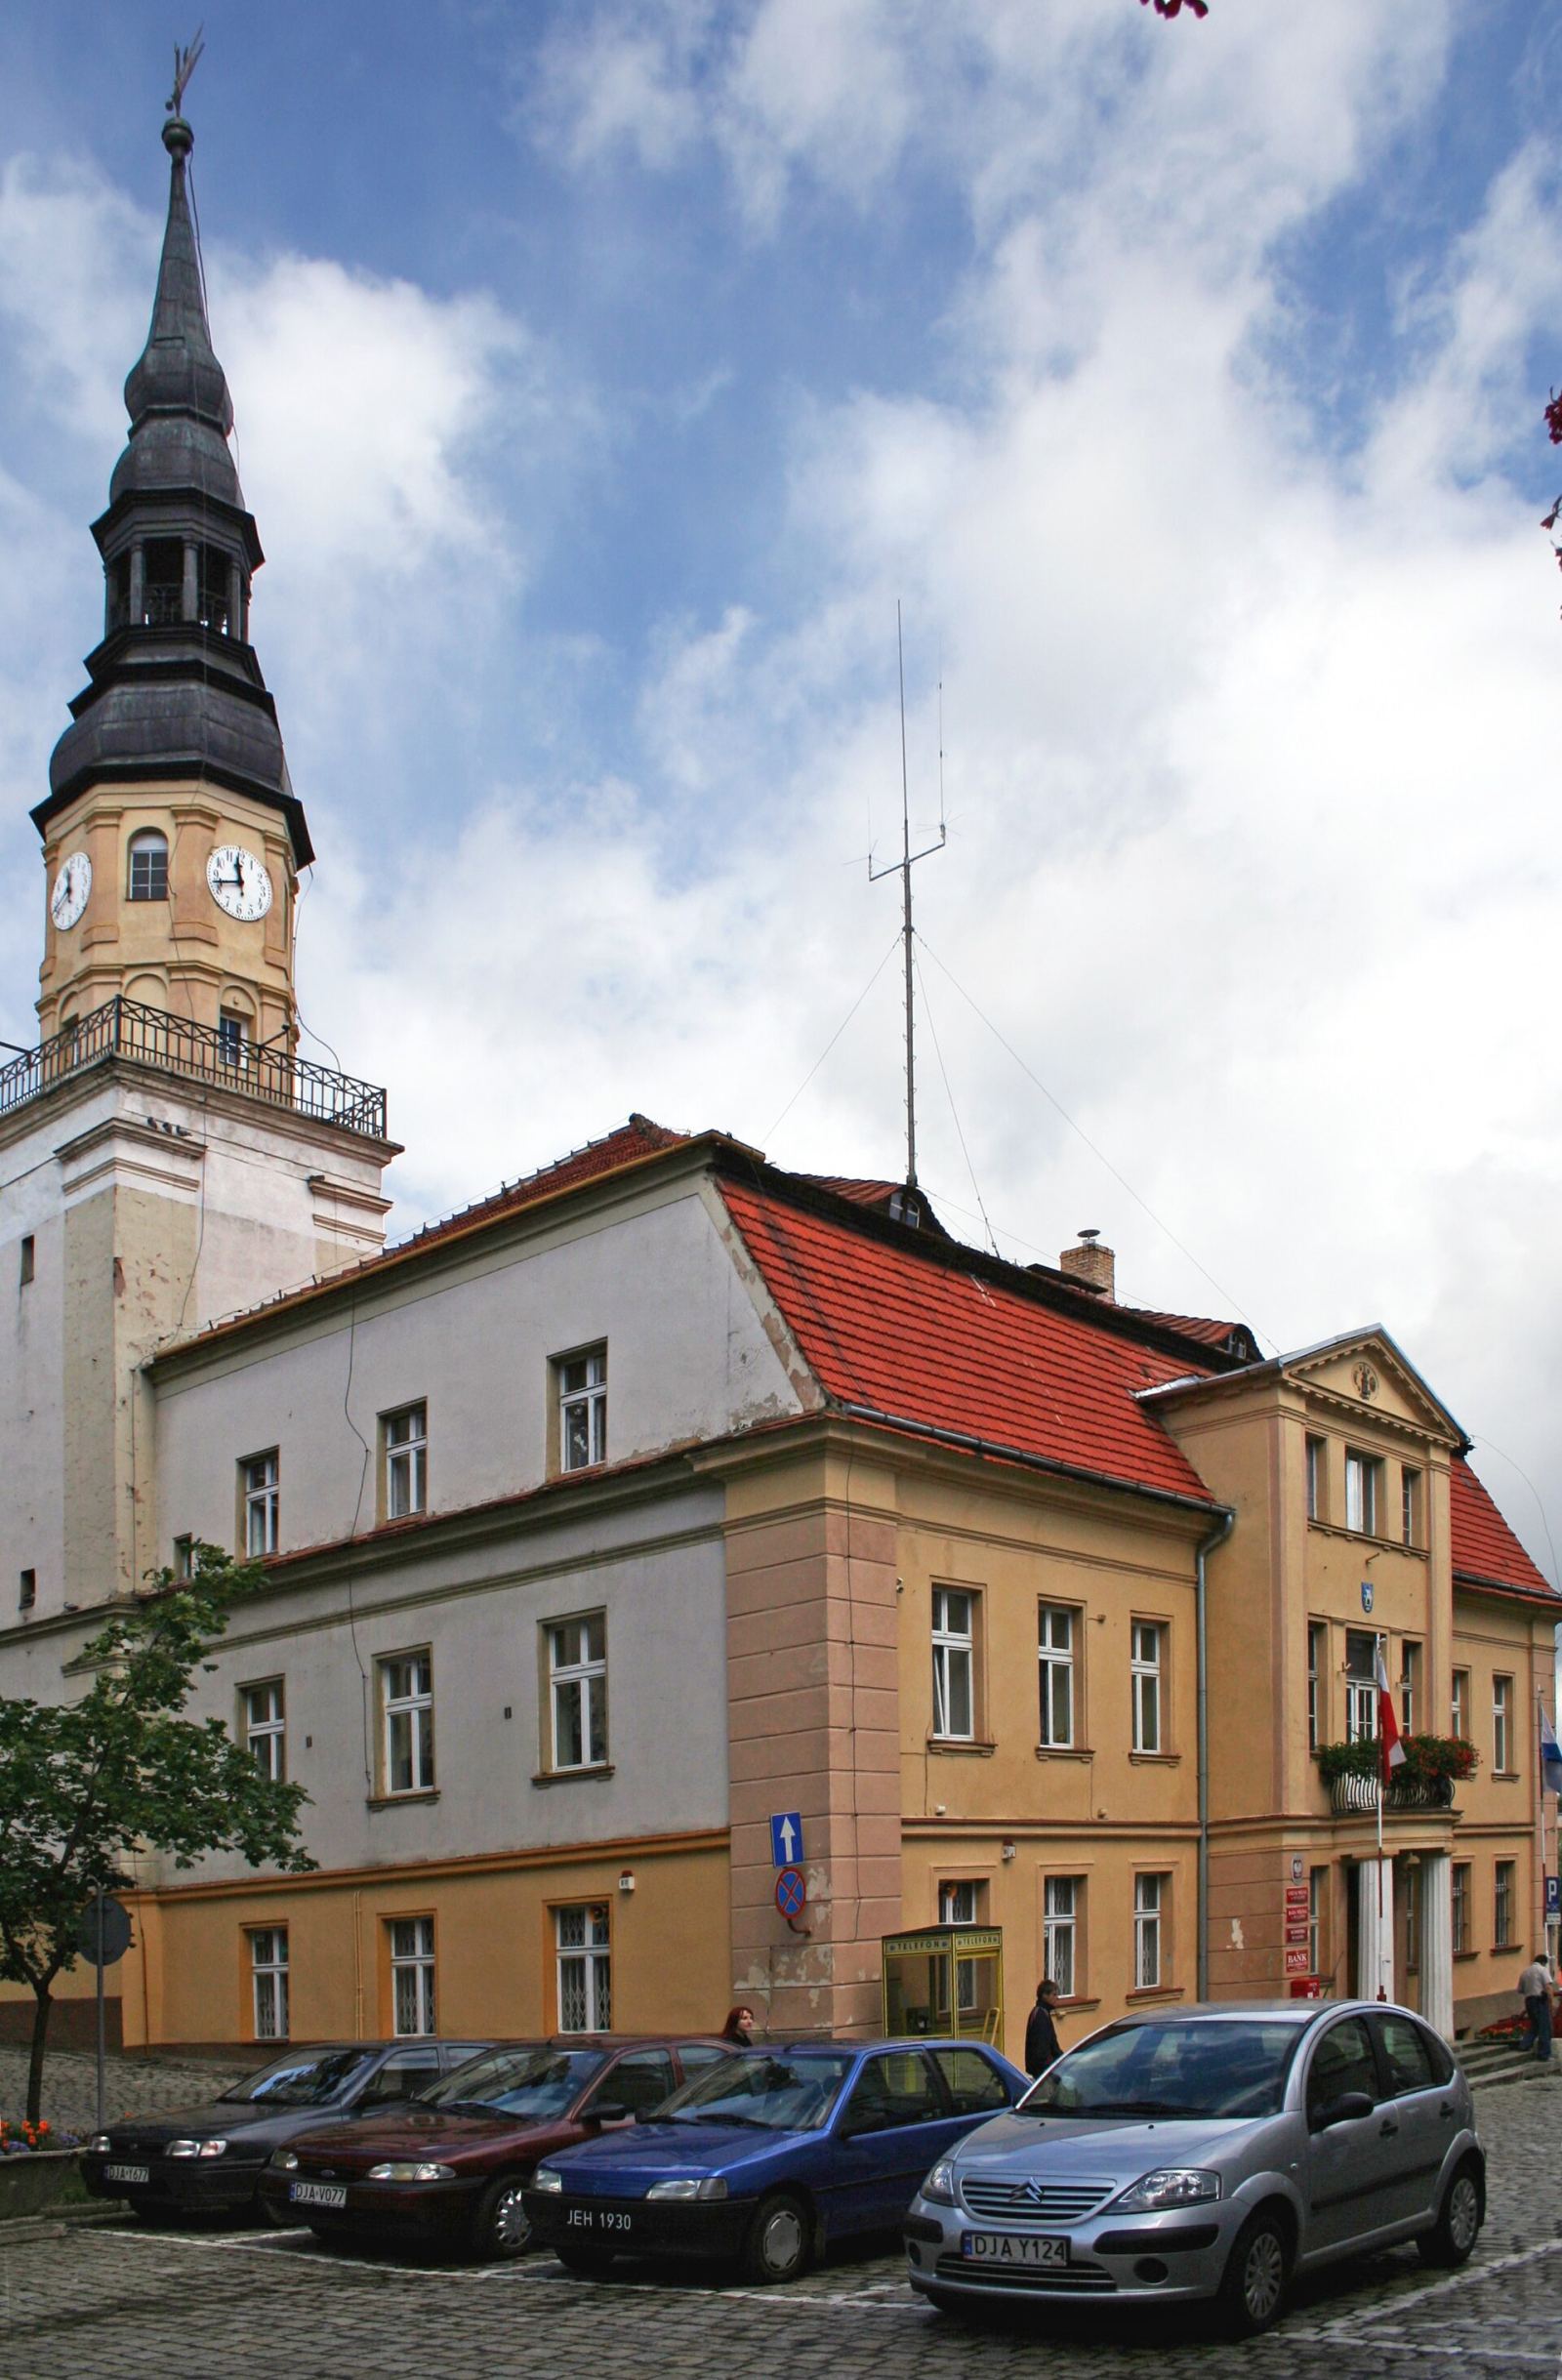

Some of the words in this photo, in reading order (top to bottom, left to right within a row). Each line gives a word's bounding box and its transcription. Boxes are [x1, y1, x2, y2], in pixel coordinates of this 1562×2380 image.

[226, 849, 232, 862] 11
[217, 856, 225, 870] 10
[236, 903, 242, 915] 6
[1548, 1879, 1557, 1903] P
[898, 1940, 939, 1950] TELEFON
[964, 1936, 993, 1946] TELEFON
[1288, 1953, 1306, 1963] BANK
[296, 2184, 315, 2199] DJA
[319, 2188, 345, 2202] V077
[567, 2209, 593, 2227] JEH
[599, 2212, 632, 2231] 1930
[975, 2236, 1012, 2257] DJA
[1019, 2239, 1066, 2260] Y124
